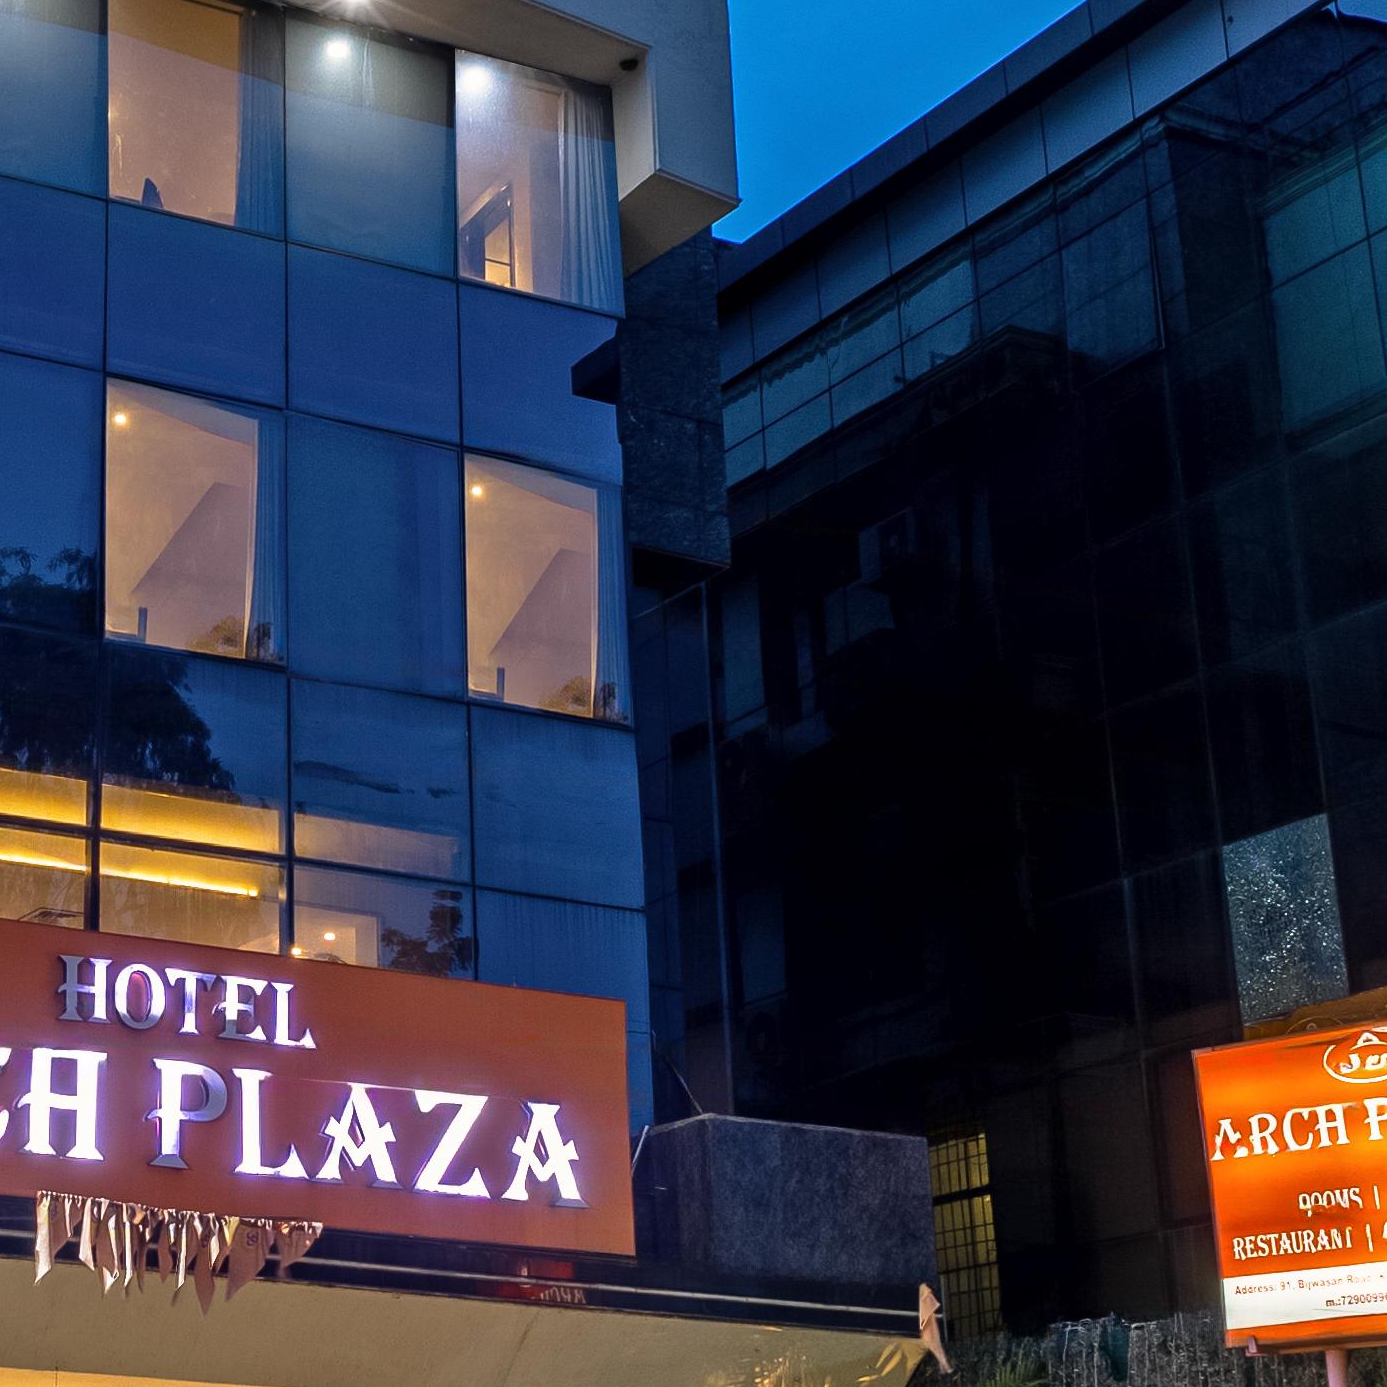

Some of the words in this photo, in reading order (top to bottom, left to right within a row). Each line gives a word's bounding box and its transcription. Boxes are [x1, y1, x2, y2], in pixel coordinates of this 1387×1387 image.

[57, 954, 317, 1050] HOTEL
[143, 1057, 592, 1208] PLAZA
[1210, 1103, 1350, 1162] ARCH
[1233, 1227, 1353, 1261] RESTAURANT
